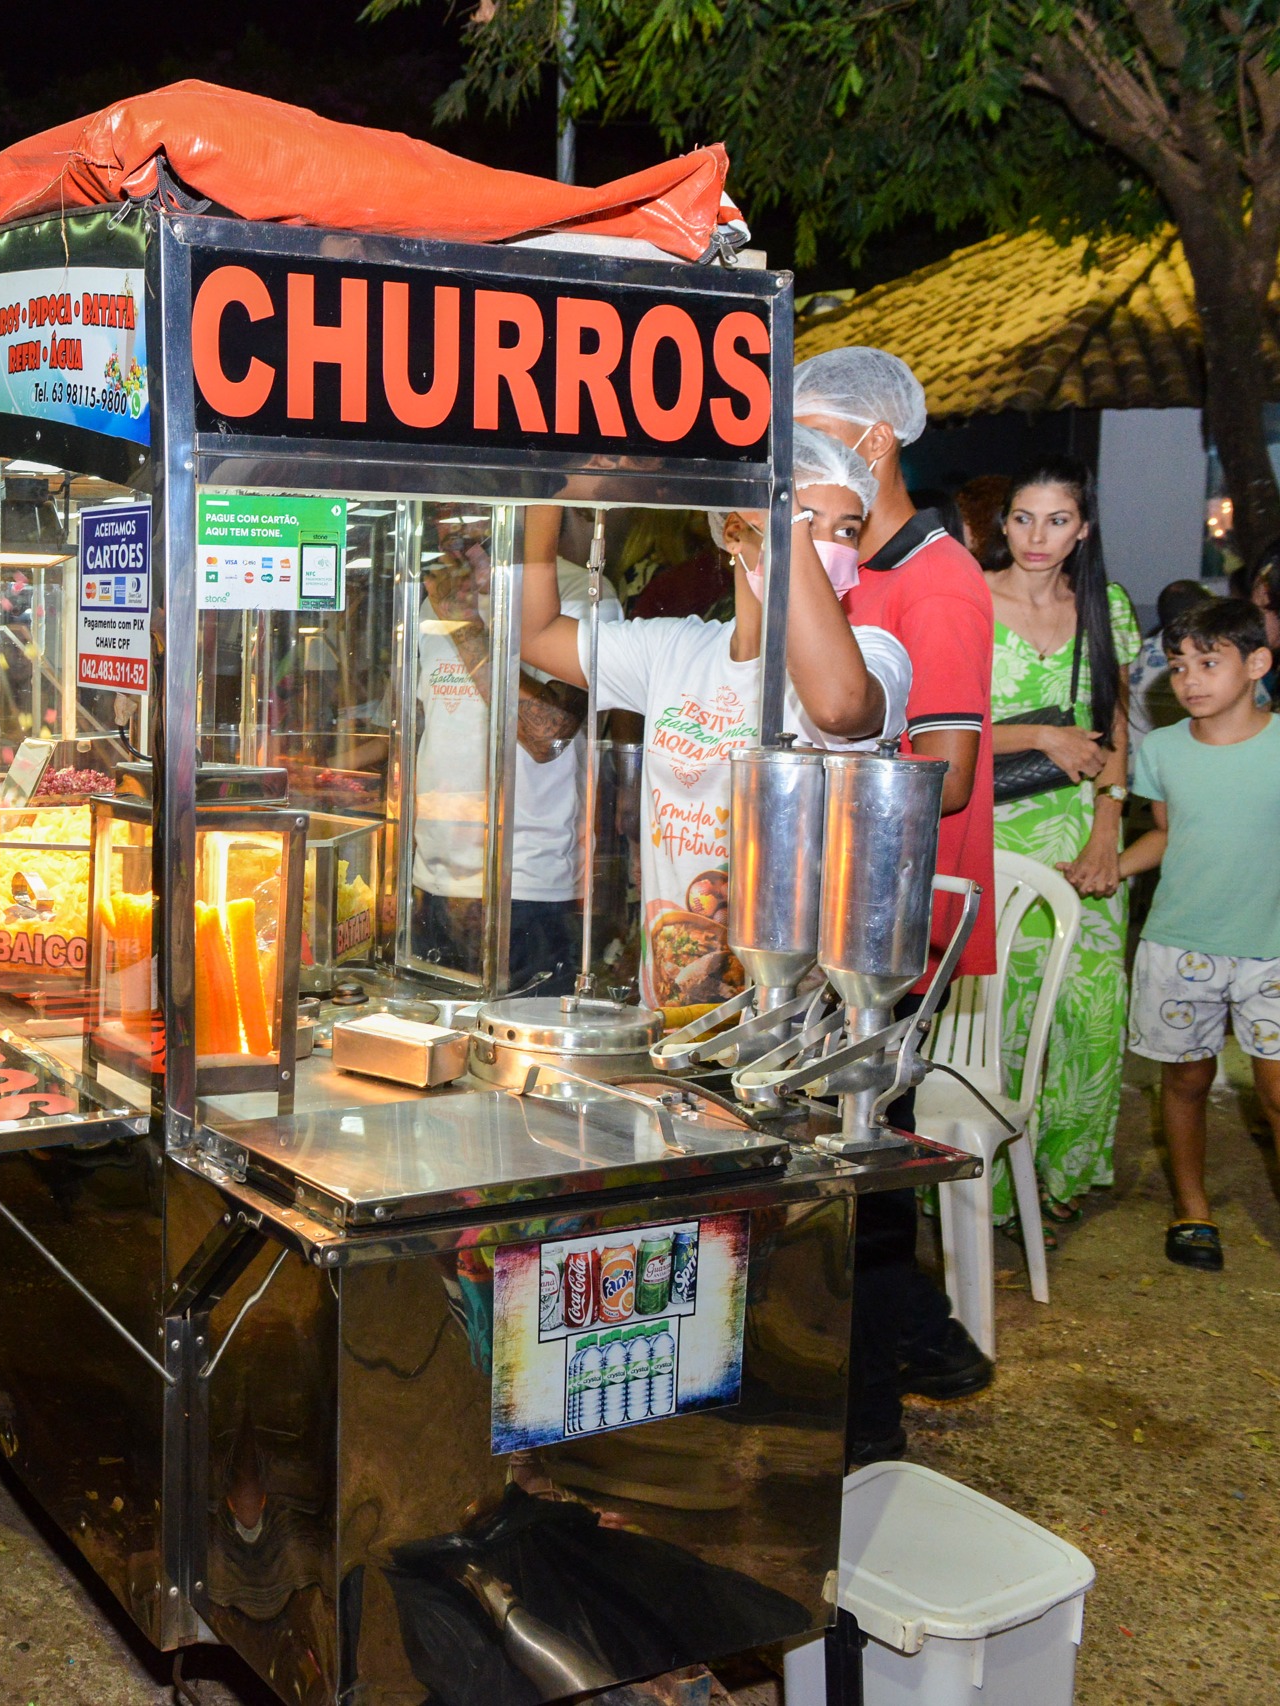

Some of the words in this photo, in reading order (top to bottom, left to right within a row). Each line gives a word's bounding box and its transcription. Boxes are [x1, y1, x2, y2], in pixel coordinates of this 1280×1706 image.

[28, 293, 72, 329] PIPOCA
[82, 293, 135, 330] BATATA
[8, 340, 41, 374] REFRI
[49, 330, 83, 370] ÁGUA
[191, 265, 771, 447] CHURROS
[34, 382, 49, 402] Tel.
[52, 381, 63, 403] 63
[66, 383, 128, 415] 98115-9800
[205, 513, 236, 523] PAGUE
[237, 514, 260, 524] COM
[261, 514, 300, 526] CARTÃO,
[94, 520, 136, 537] ACEITAMOS
[205, 527, 228, 537] AQUI
[230, 528, 249, 537] TEM
[251, 528, 282, 538] STONE.
[86, 538, 144, 570] CARTÕES
[205, 594, 227, 603] stone
[84, 617, 117, 632] Pagamento
[117, 621, 131, 630] com
[132, 619, 144, 631] PIX
[95, 637, 116, 648] CHAVE
[118, 638, 130, 650] CPF
[81, 659, 145, 685] 042.483.311-52
[662, 822, 730, 864] Afetiva
[337, 908, 371, 955] BATATA
[630, 1366, 649, 1374] crystal
[654, 1362, 672, 1370] crystal
[607, 1371, 625, 1379] crystal
